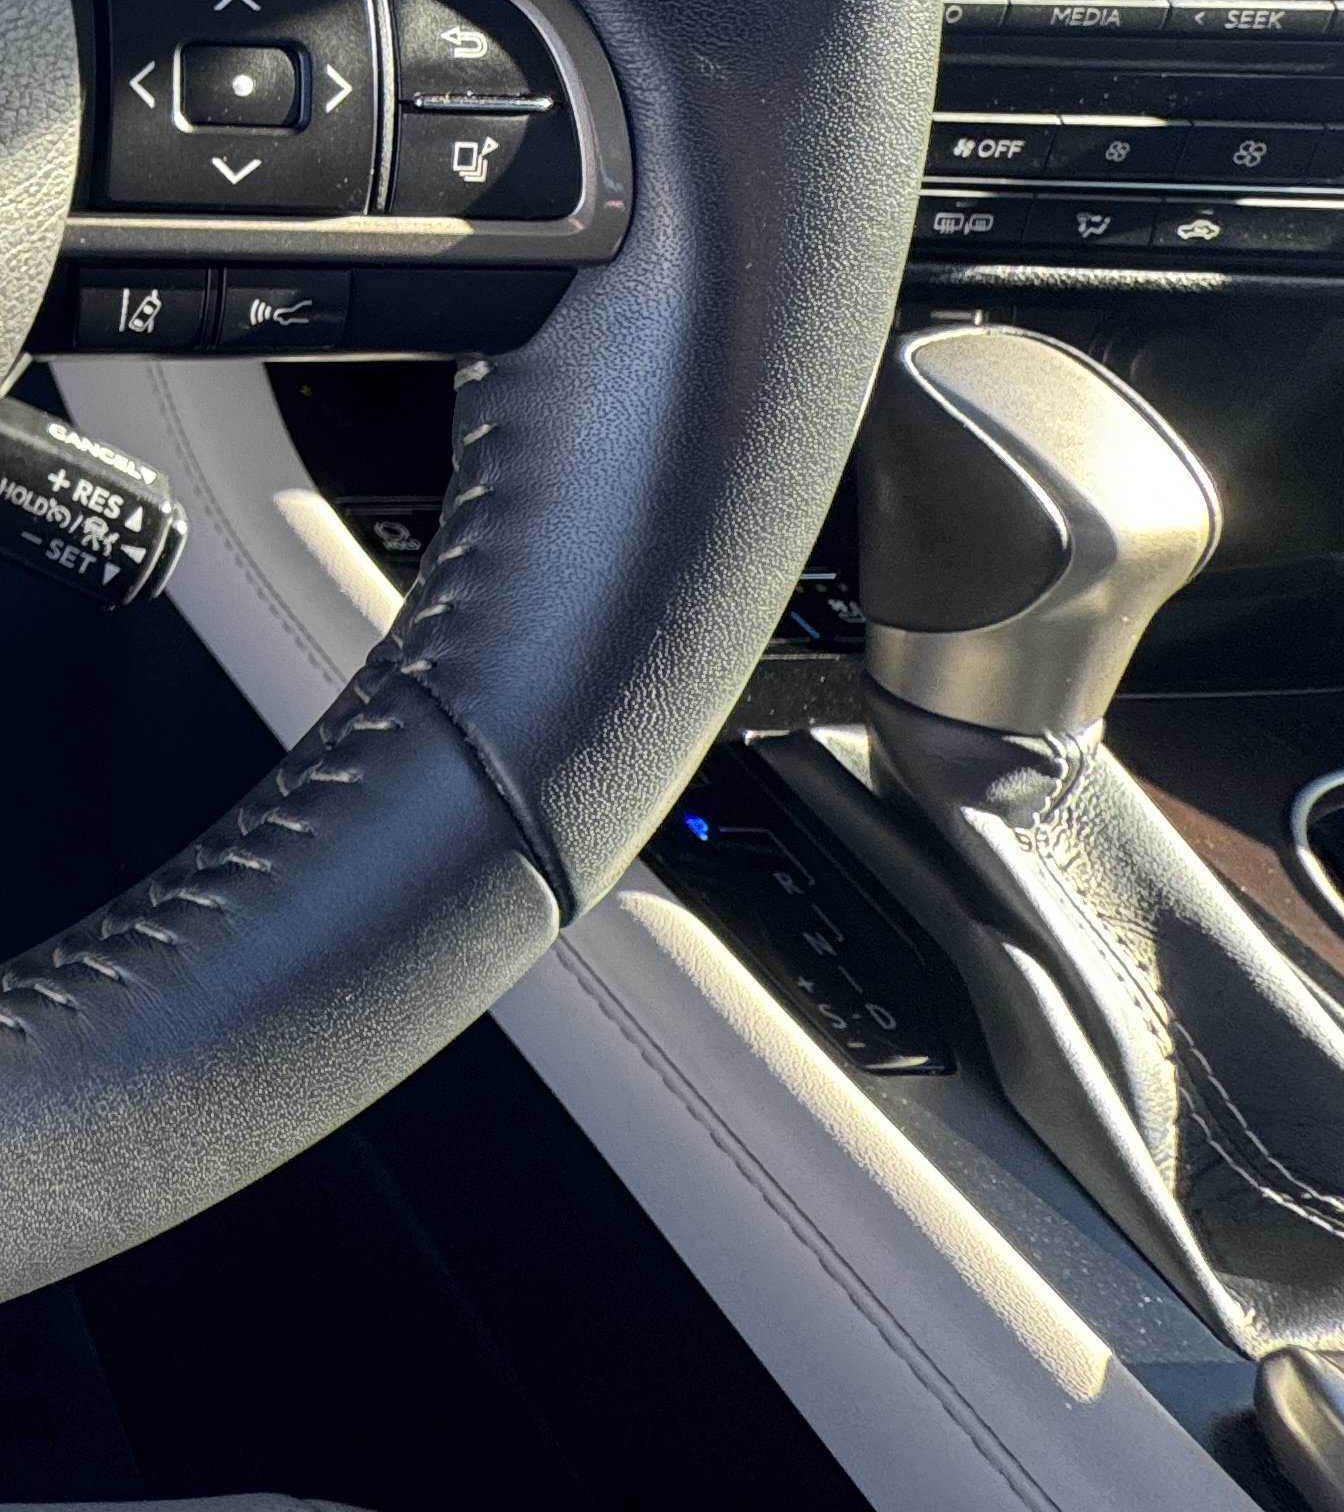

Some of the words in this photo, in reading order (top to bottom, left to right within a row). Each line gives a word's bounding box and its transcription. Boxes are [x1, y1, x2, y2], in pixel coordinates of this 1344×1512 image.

[1050, 7, 1122, 27] MEDIA
[1224, 10, 1286, 30] SEEK
[977, 138, 1026, 159] OFF
[48, 423, 142, 481] CANCEL
[72, 478, 124, 520] RES
[45, 538, 98, 575] SET
